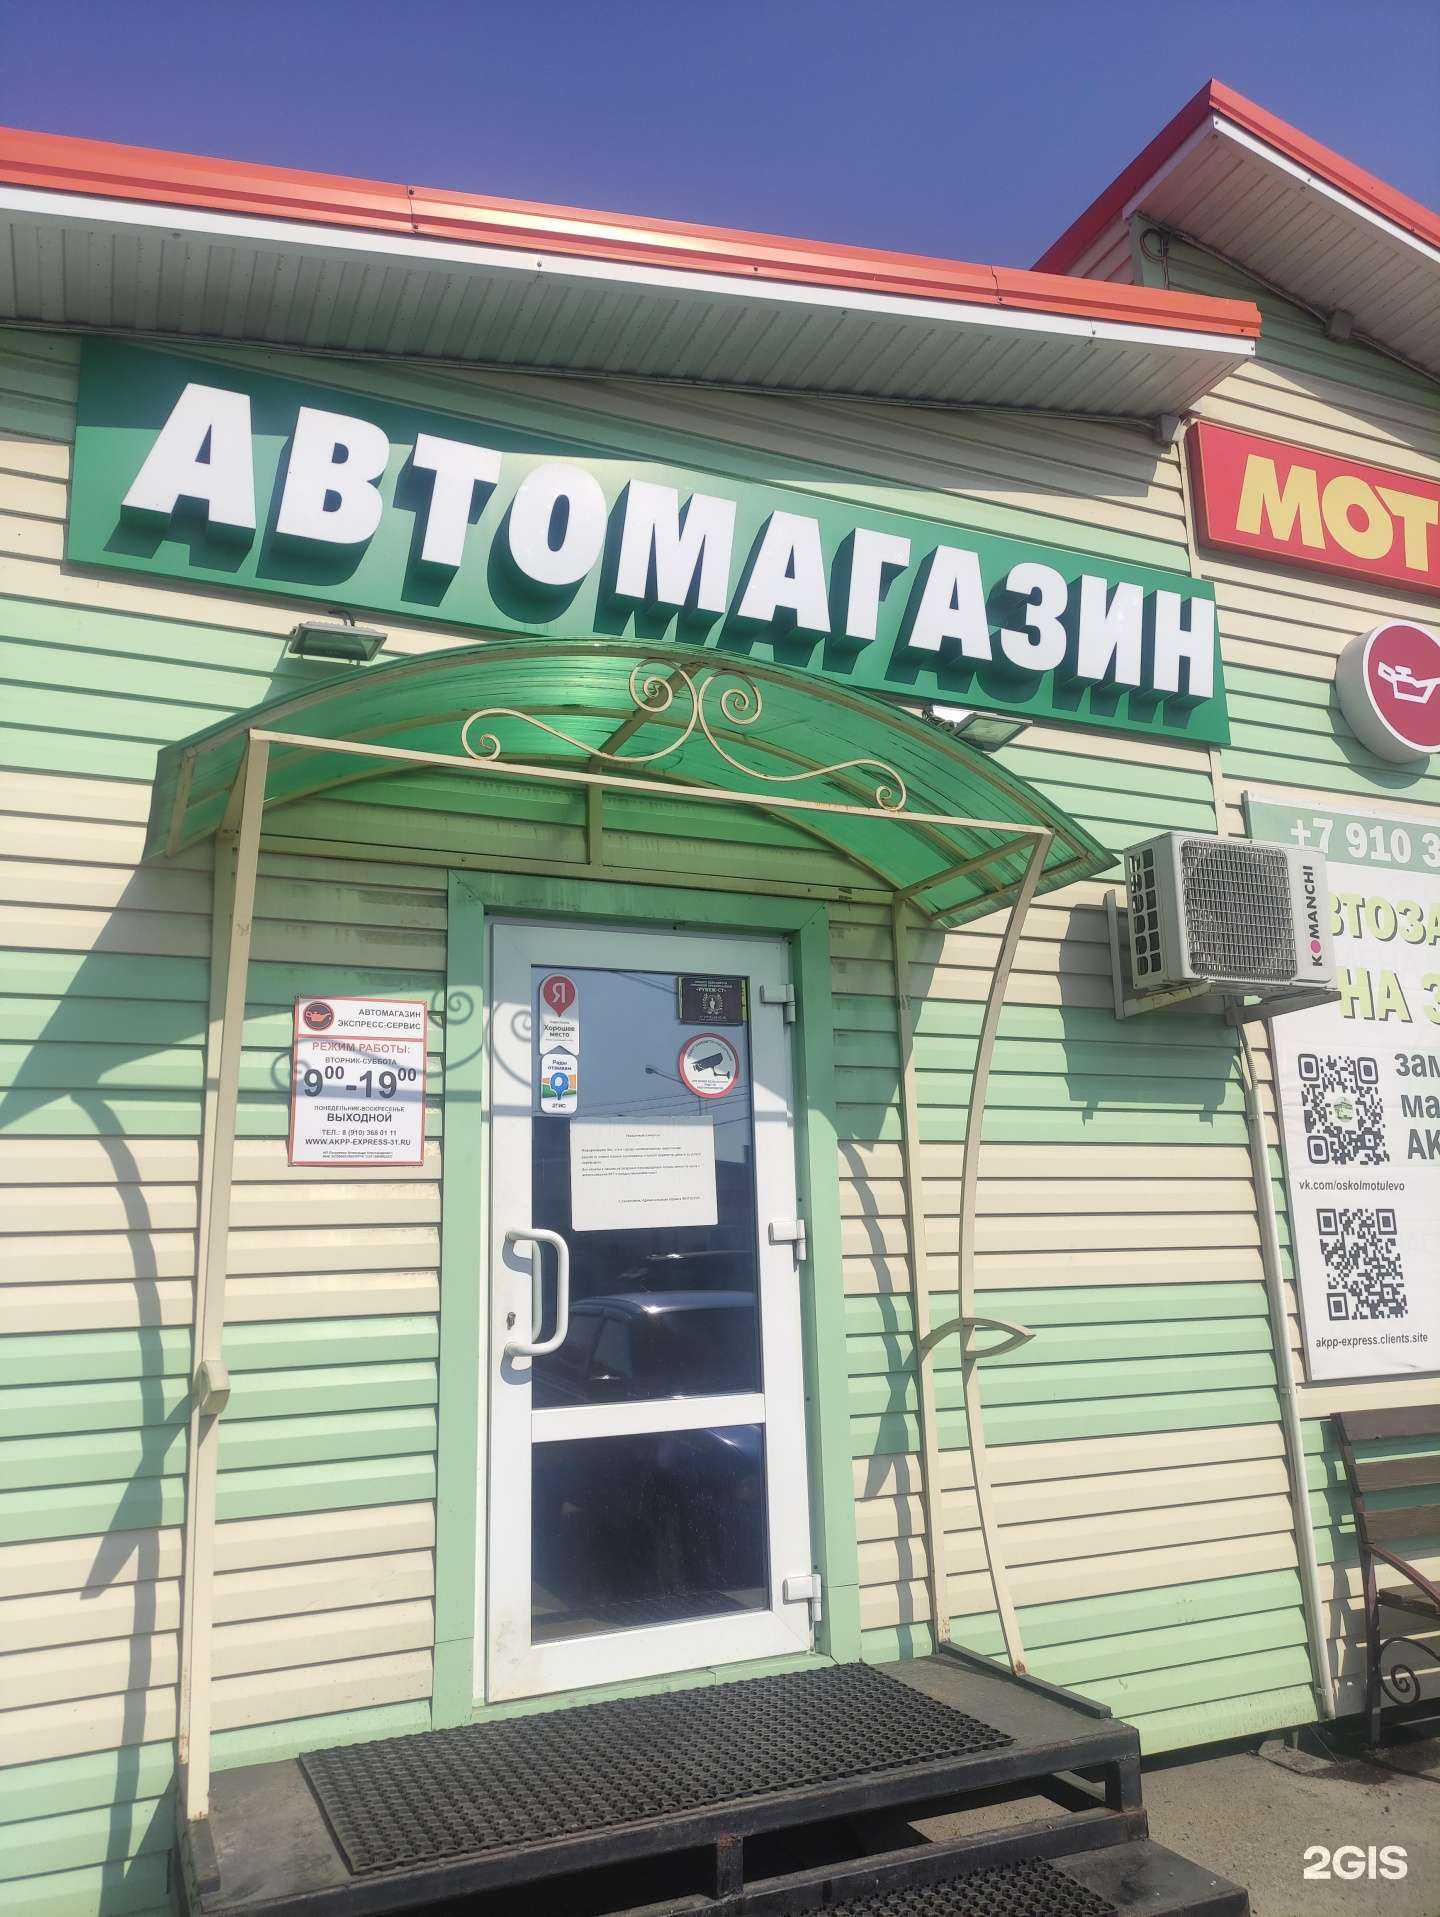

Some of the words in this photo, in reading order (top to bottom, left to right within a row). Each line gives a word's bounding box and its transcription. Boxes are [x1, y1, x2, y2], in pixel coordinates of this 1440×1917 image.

[120, 383, 1215, 700] АВТОМАГАЗИН
[1290, 817, 1334, 854] +7
[1345, 822, 1411, 864] 910
[552, 982, 566, 1003] Я
[1337, 966, 1413, 1023] НА
[358, 1008, 421, 1018] АВТОМАГАЗИН
[337, 1019, 421, 1030] ЭКСПРЕСС-СЕРВИС
[544, 1024, 576, 1033] Хорошее
[312, 1041, 355, 1052] РЕЖИМ
[358, 1042, 411, 1054] РАБОТЫ:
[325, 1056, 397, 1066] ВТОРНИК-СУББОТА
[314, 1105, 405, 1113] ПОНЕДЕЛЬНИК-ВОСКРЕСЕНЬЕ
[327, 1112, 392, 1123] ВЫХОДНОЙ
[348, 1129, 365, 1137] (910)
[305, 1138, 411, 1146] WWW.AKPP-EXPRESS-31.RU
[1299, 1179, 1406, 1193] vk.com/oskolmotulevo
[1315, 1332, 1429, 1349] akpp-express.clients.site
